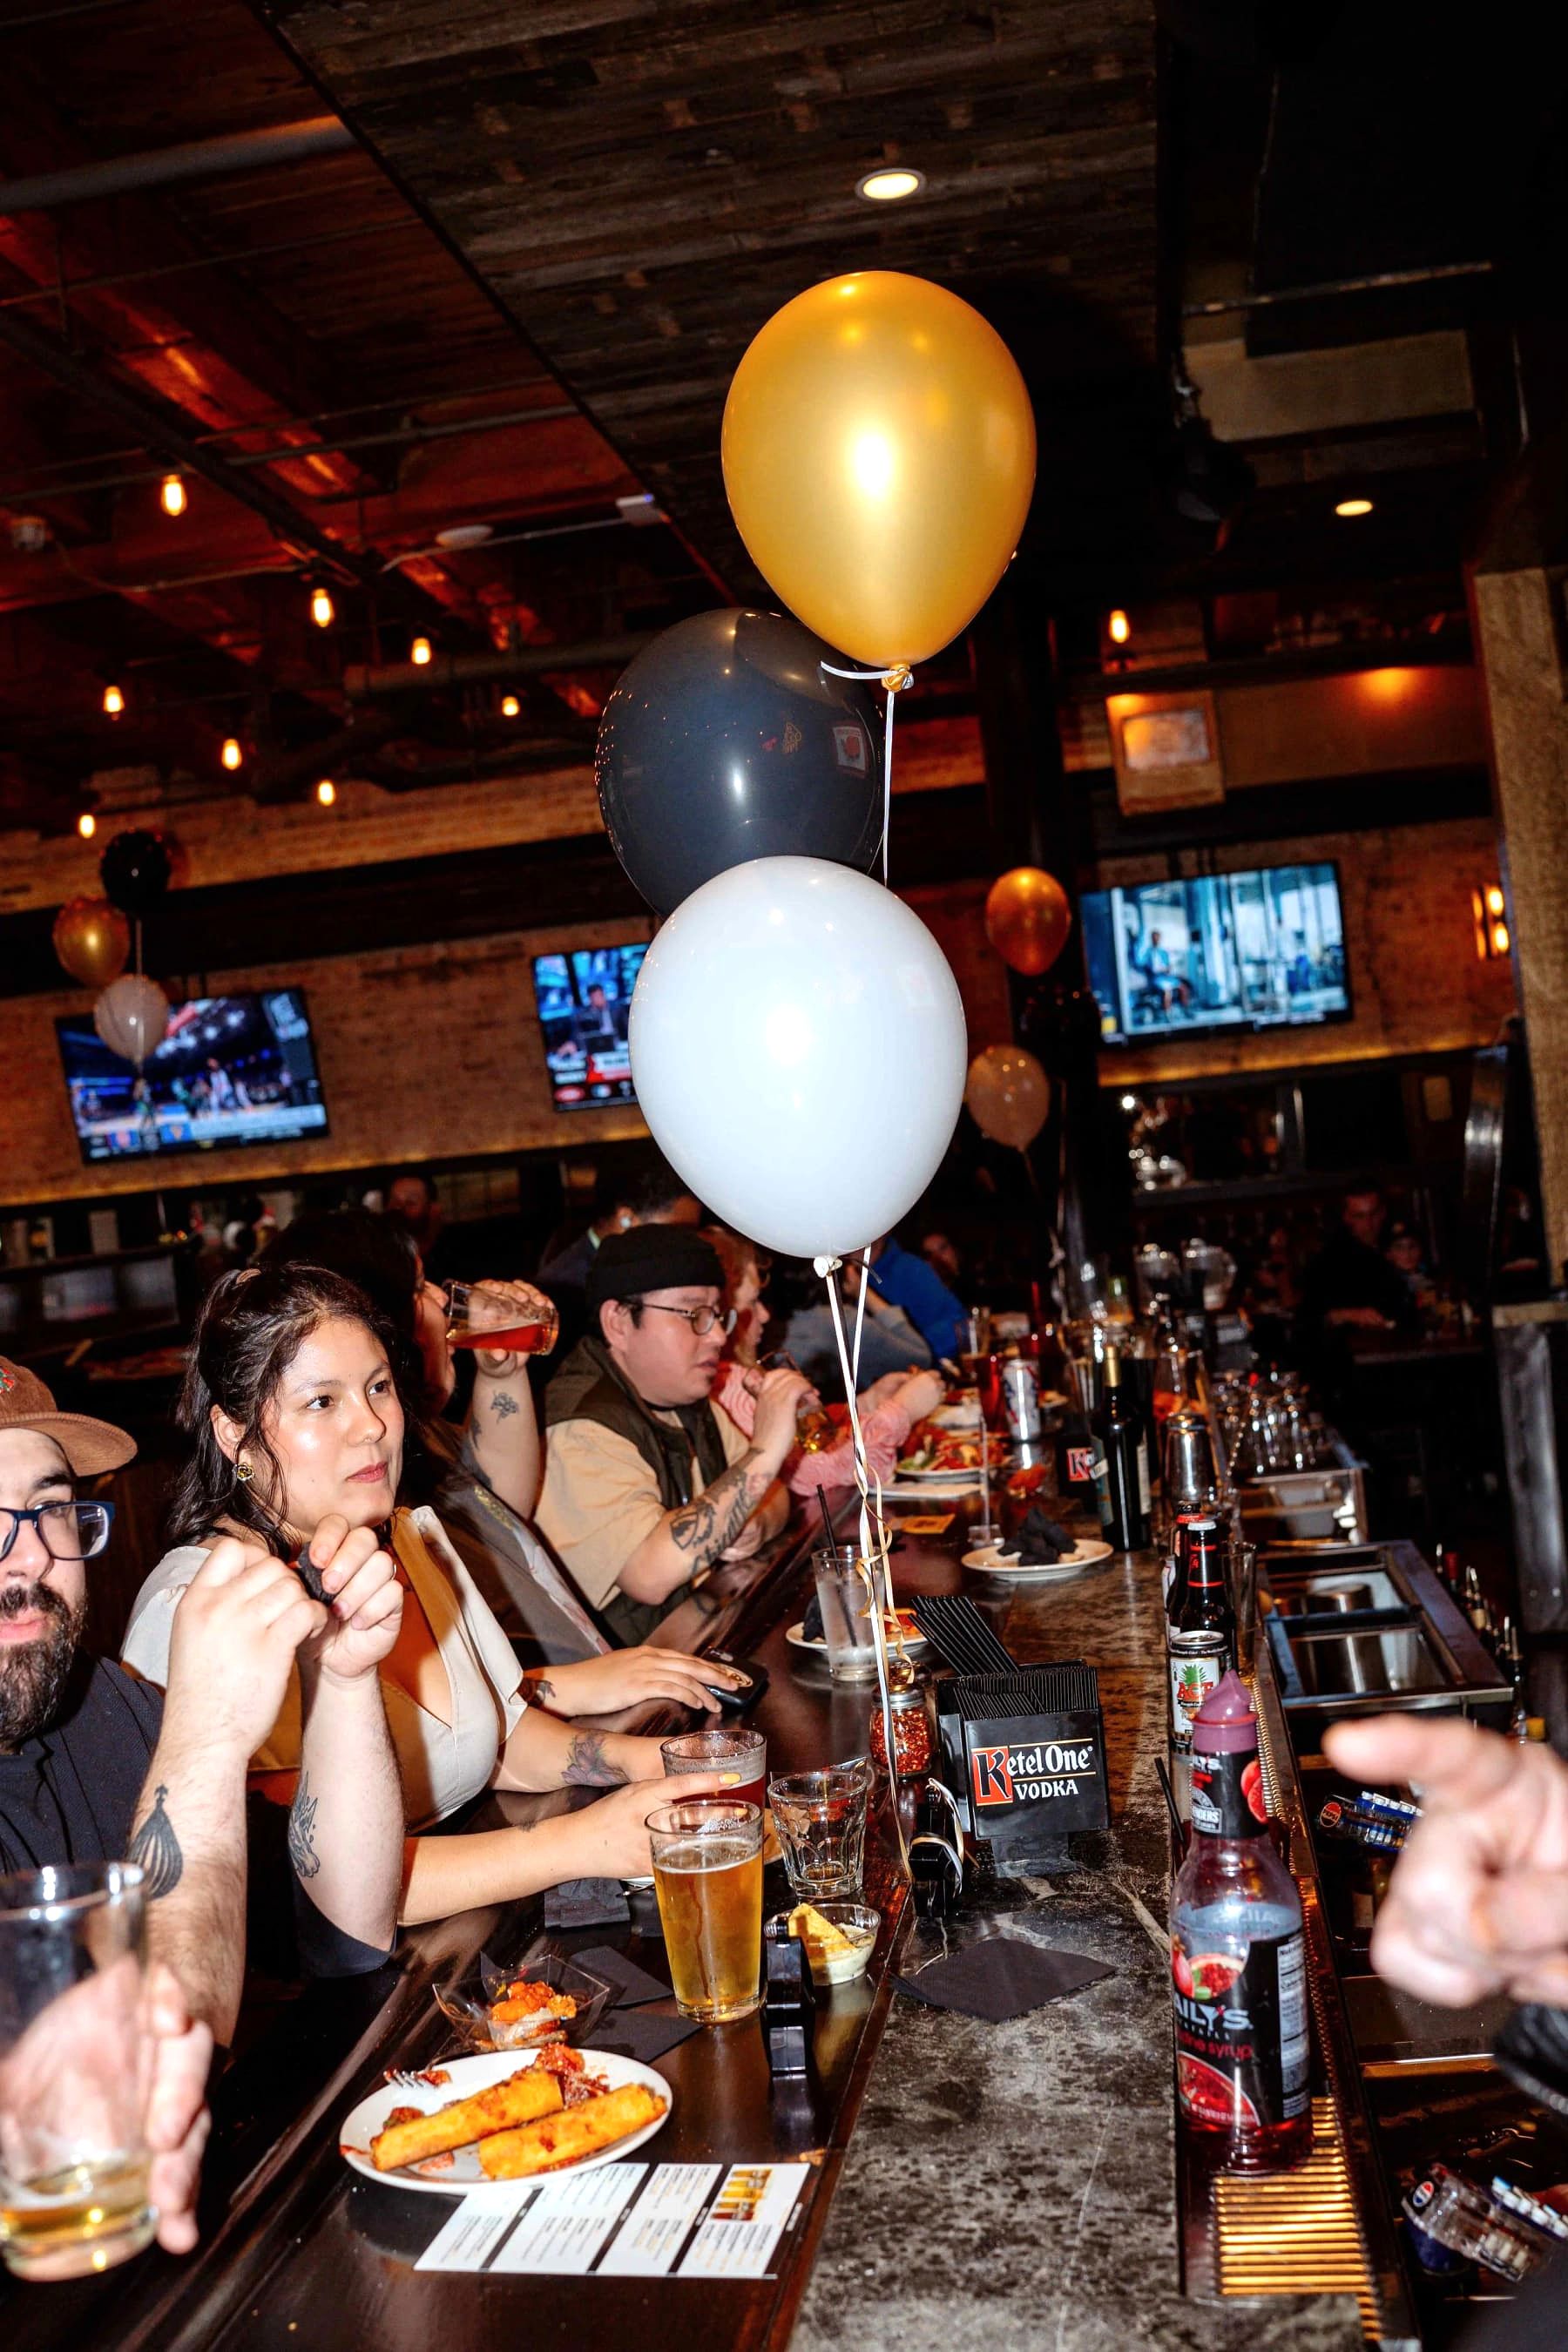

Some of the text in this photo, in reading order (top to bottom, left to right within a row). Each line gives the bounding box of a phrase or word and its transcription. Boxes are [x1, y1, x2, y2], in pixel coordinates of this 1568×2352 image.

[975, 1745, 1090, 1800] Ketel One
[1014, 1779, 1078, 1800] VODKA
[1208, 2041, 1254, 2062] syrup
